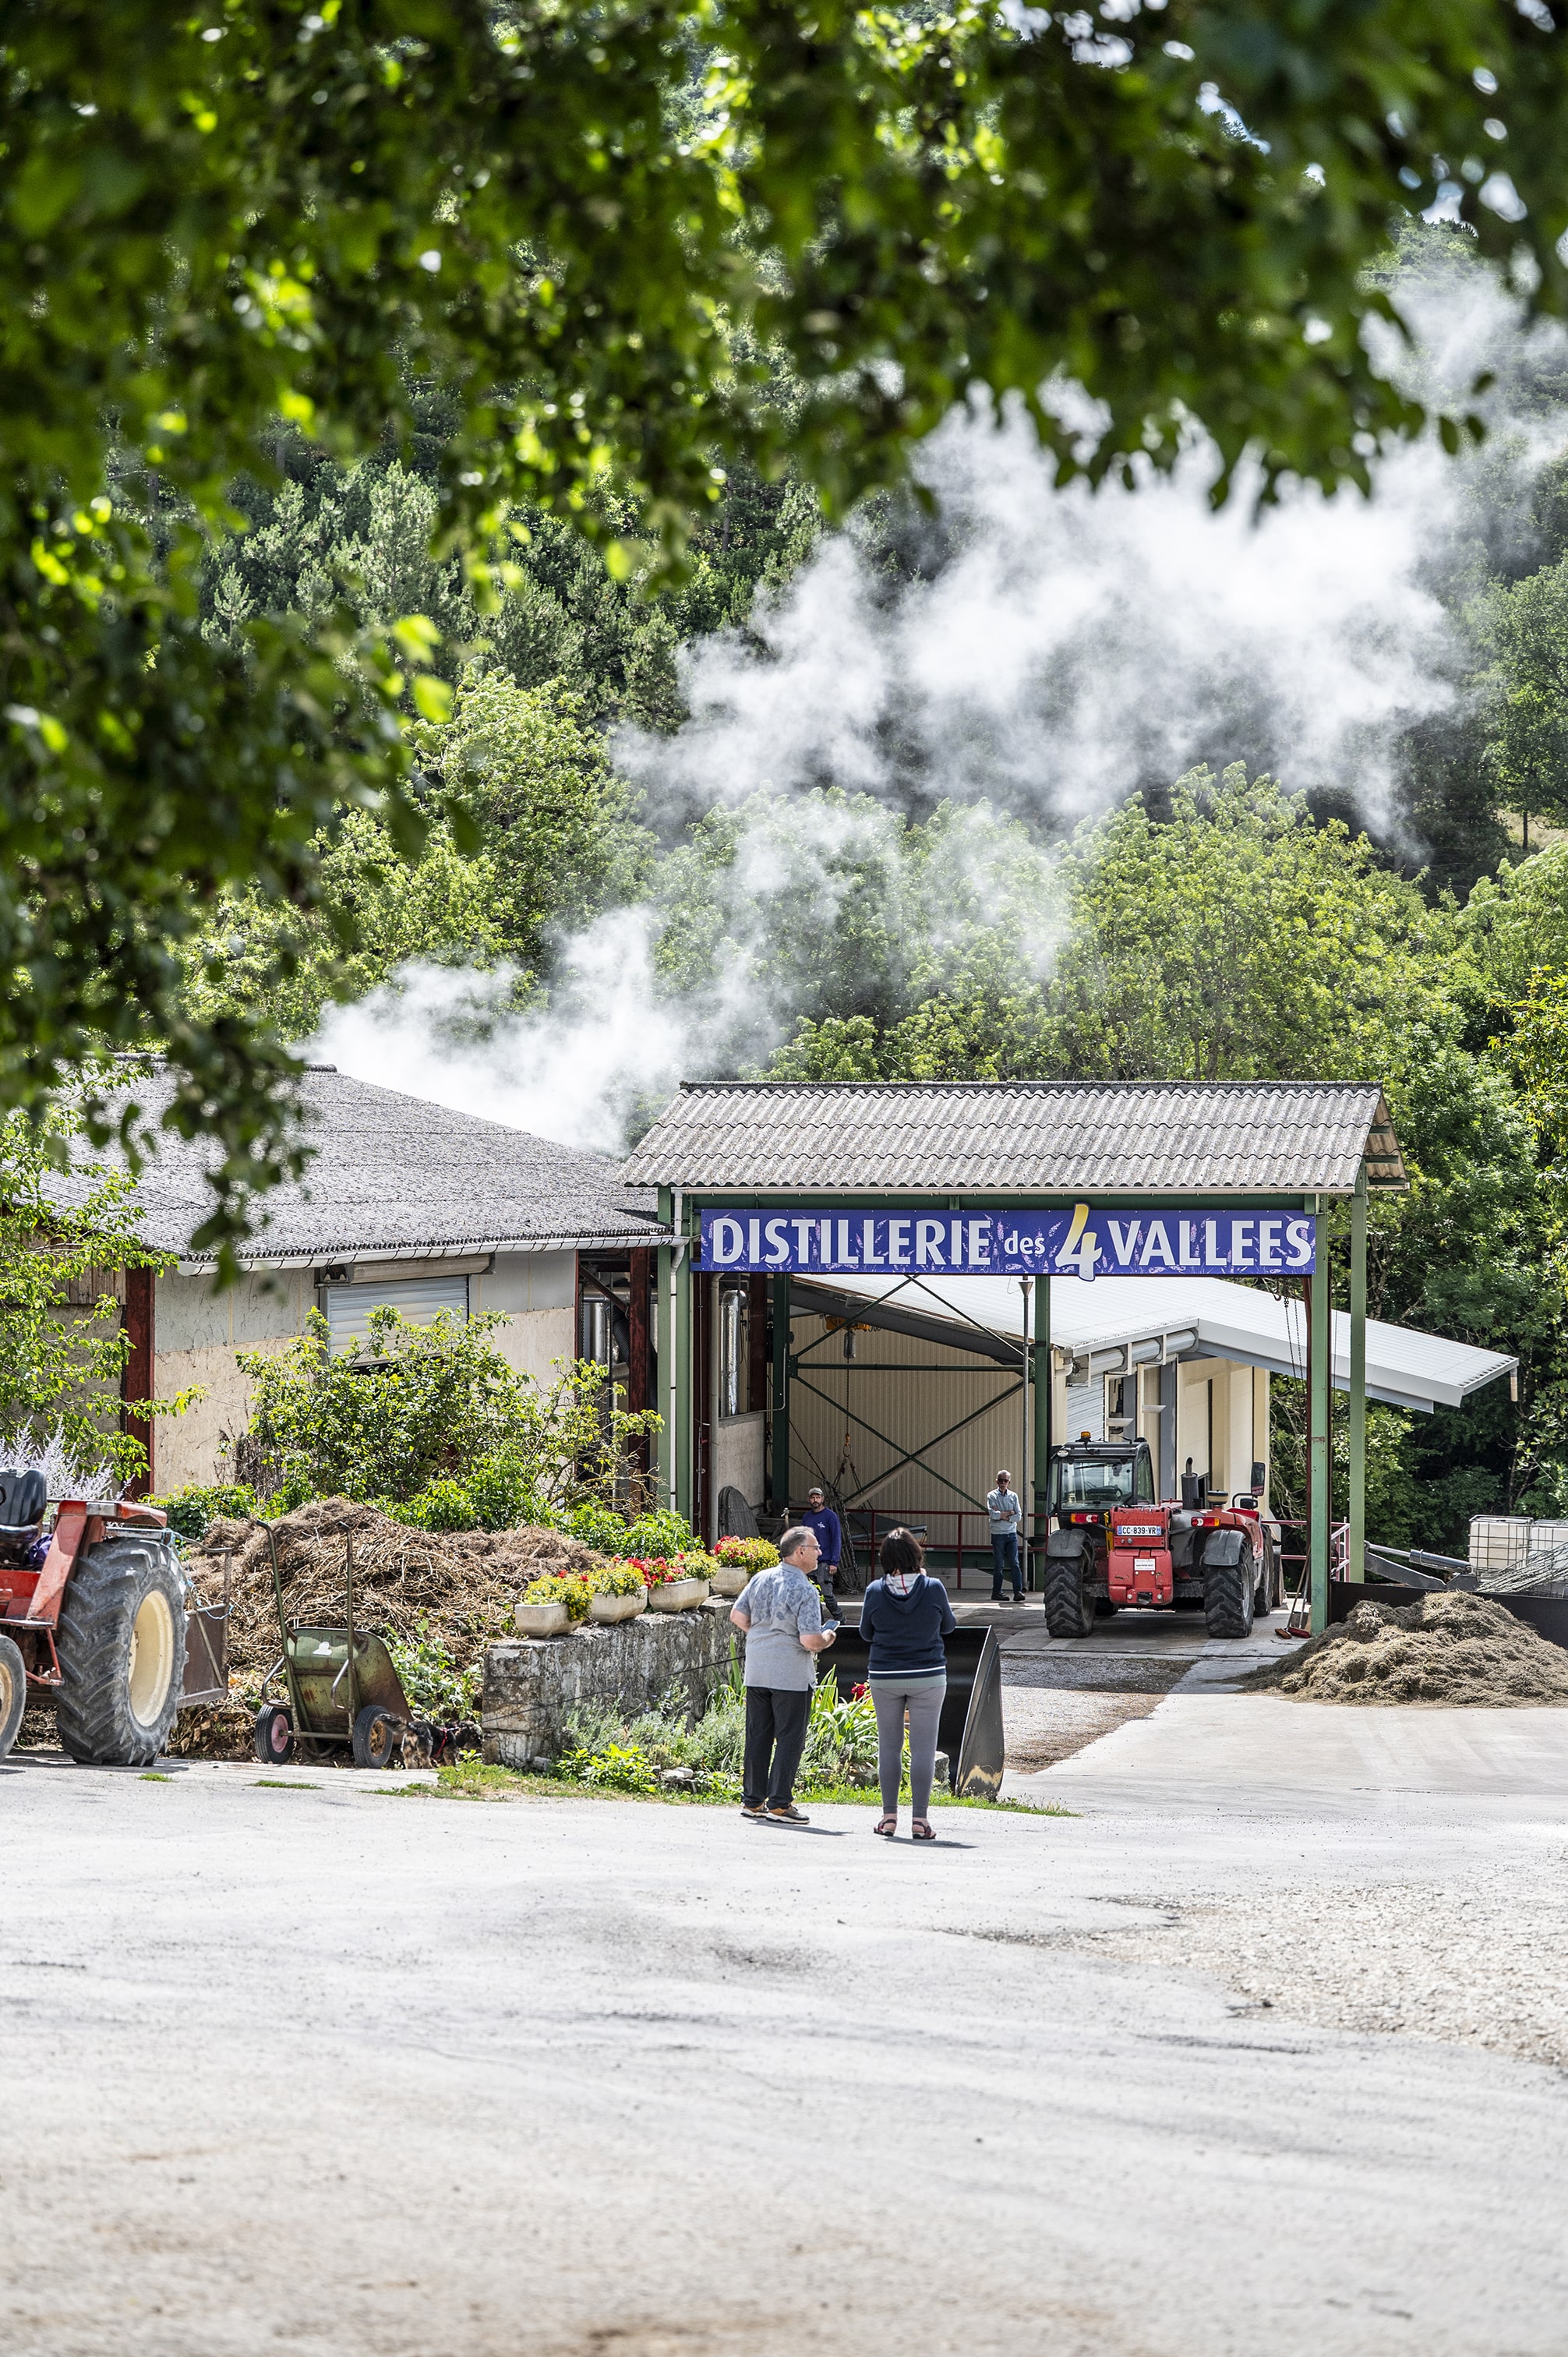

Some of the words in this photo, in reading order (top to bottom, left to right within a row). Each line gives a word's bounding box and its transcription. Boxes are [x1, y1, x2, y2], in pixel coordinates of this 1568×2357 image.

[712, 1218, 991, 1266] DISTILLERIE
[1004, 1230, 1045, 1255] des
[1054, 1203, 1103, 1281] 4
[1107, 1219, 1312, 1267] VALLEES
